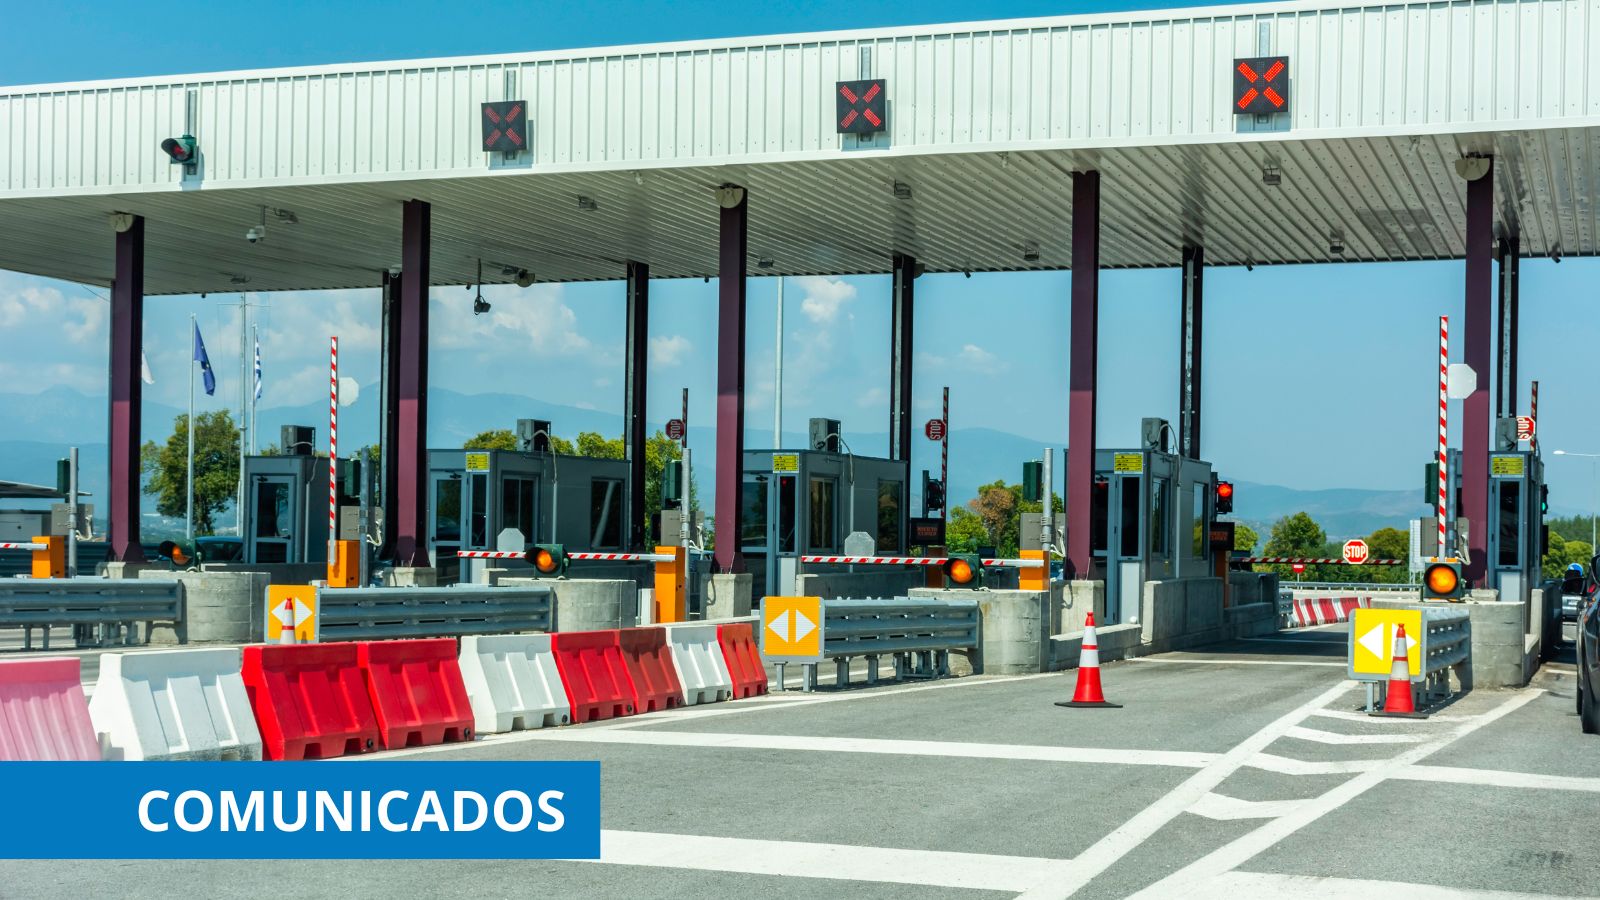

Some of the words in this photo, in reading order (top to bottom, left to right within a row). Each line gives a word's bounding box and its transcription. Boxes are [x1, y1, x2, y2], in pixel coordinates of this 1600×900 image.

[671, 420, 681, 439] STOP
[931, 420, 942, 440] STOP
[1345, 545, 1366, 559] STOP
